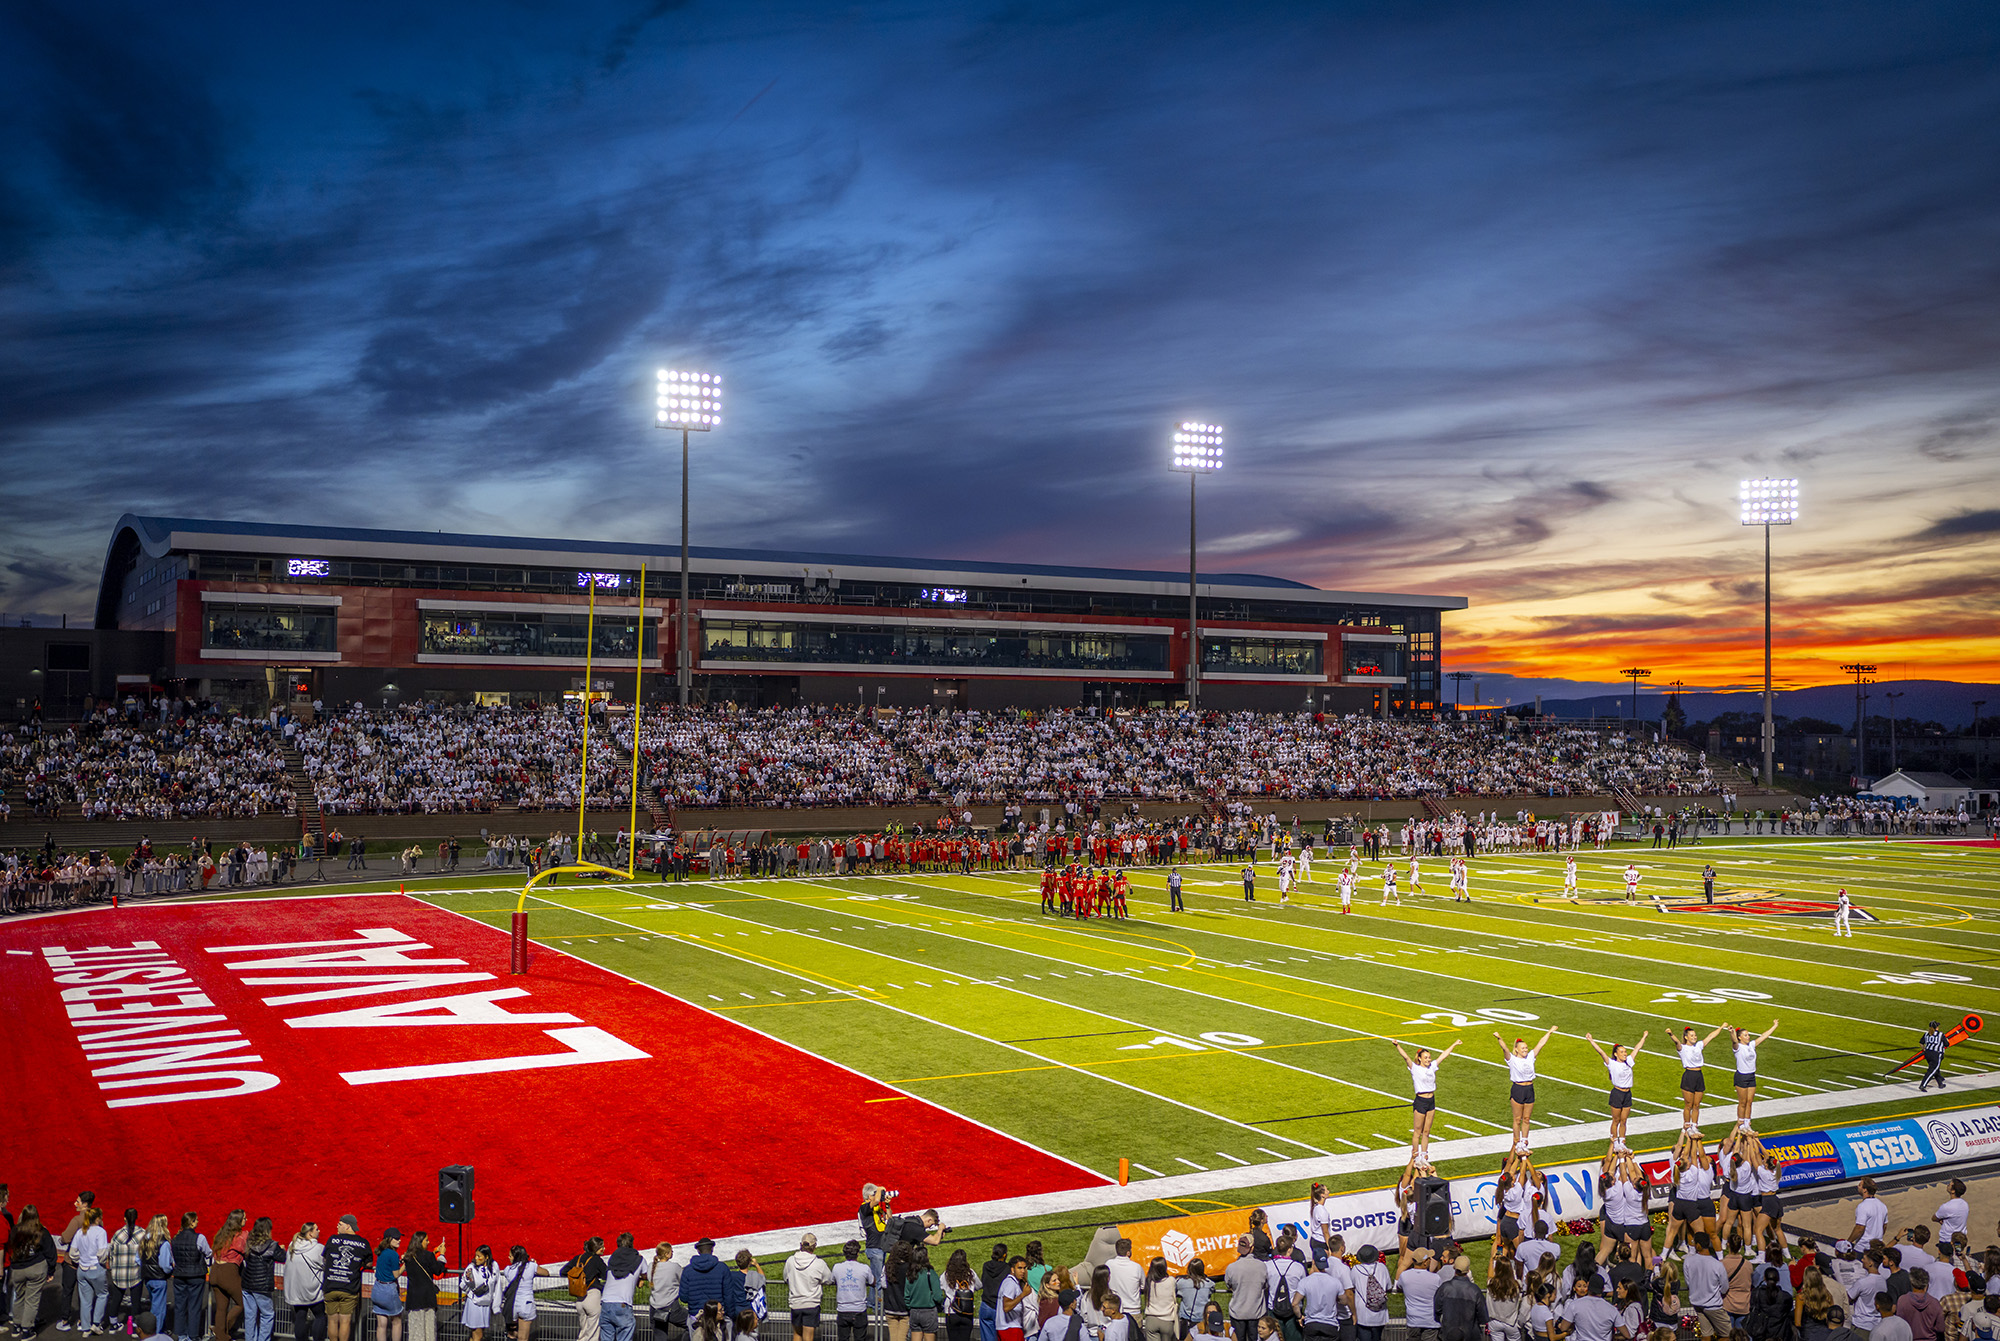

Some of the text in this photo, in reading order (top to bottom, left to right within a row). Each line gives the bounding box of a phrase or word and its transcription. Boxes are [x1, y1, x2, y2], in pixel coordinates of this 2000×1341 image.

[1661, 988, 1774, 1004] 30
[204, 928, 652, 1085] LAVAL
[1420, 1007, 1541, 1027] 20
[1148, 1031, 1264, 1051] 10
[1950, 1116, 2000, 1138] LA CAG
[1802, 1141, 1834, 1159] D'AUTO
[1849, 1134, 1924, 1170] RSEQ
[1331, 1211, 1397, 1232] SPORTS
